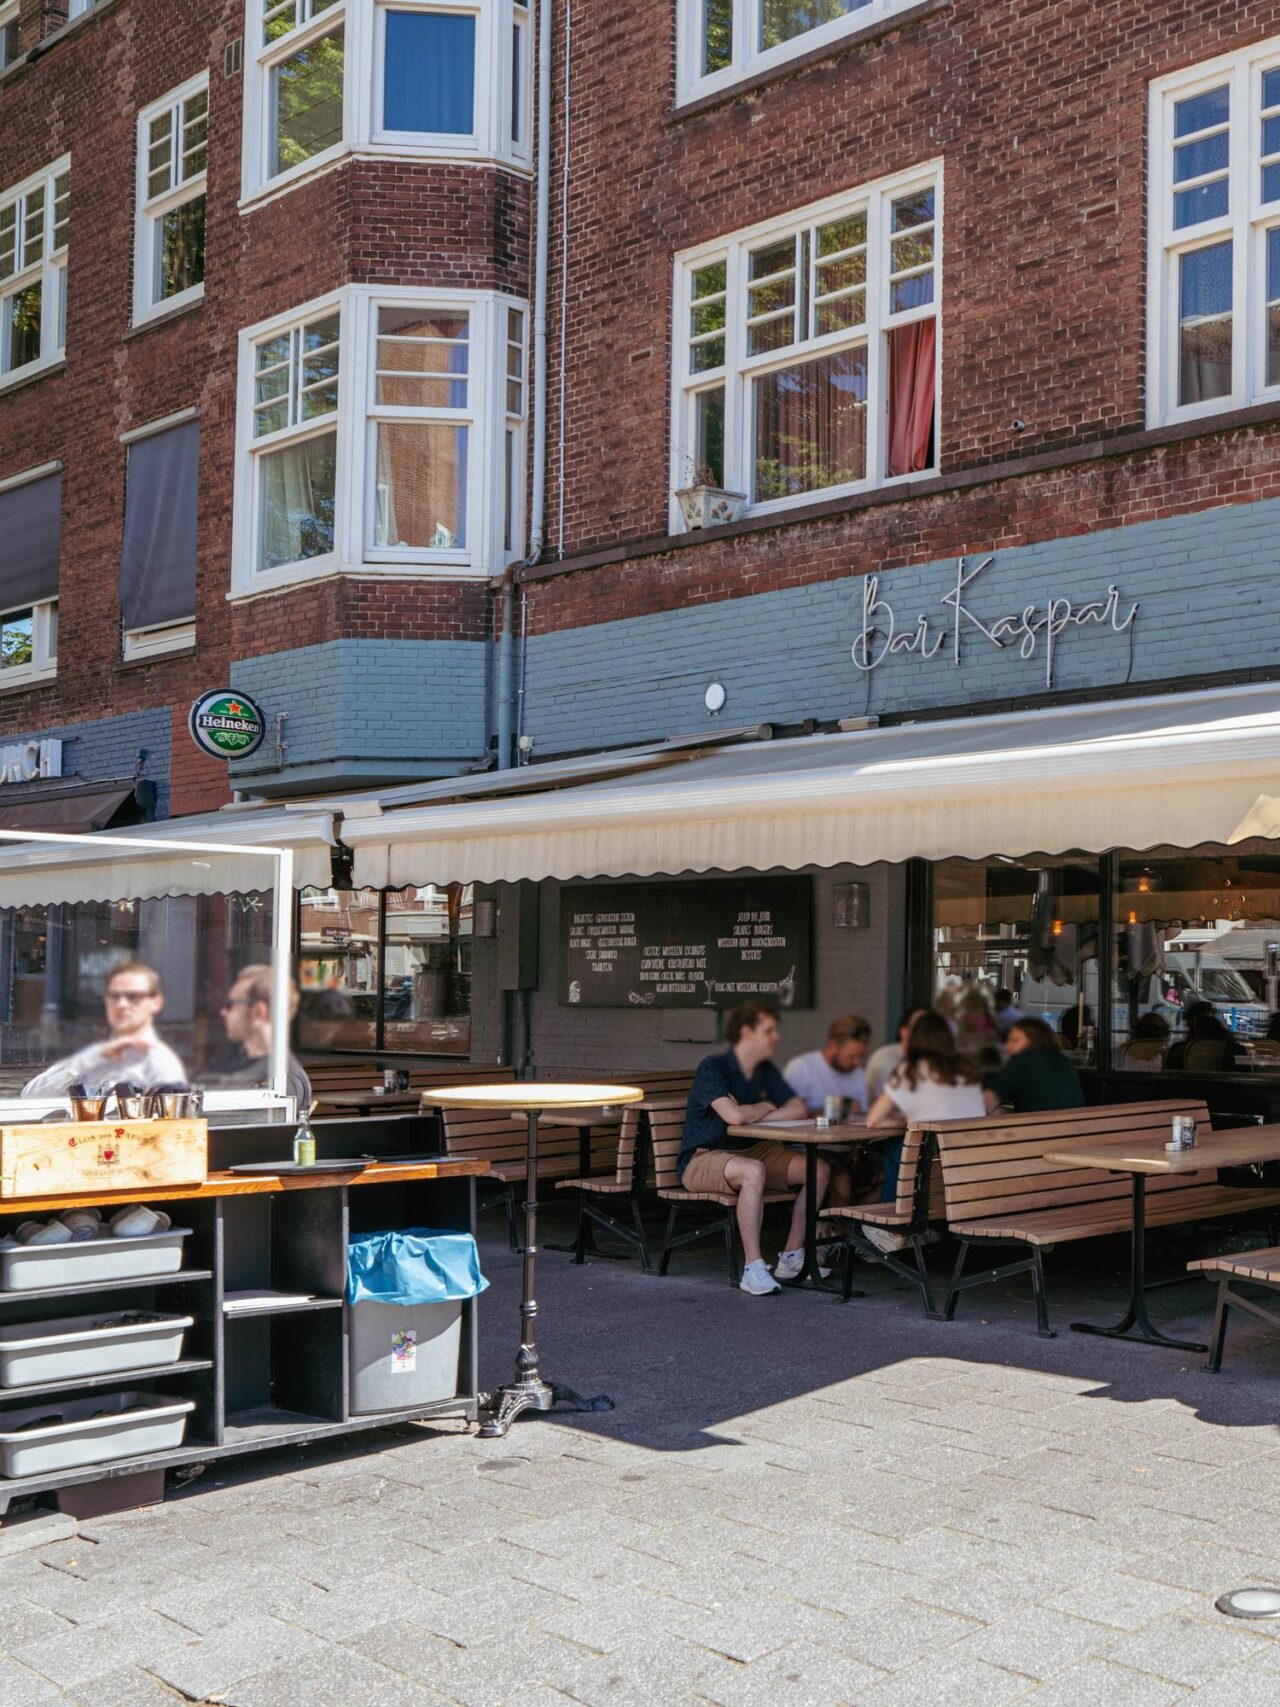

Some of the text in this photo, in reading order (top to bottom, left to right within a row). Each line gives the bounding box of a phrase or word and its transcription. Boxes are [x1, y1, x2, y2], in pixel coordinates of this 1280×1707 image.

[851, 557, 1141, 689] Bar Kaspar
[202, 715, 260, 734] Heineken
